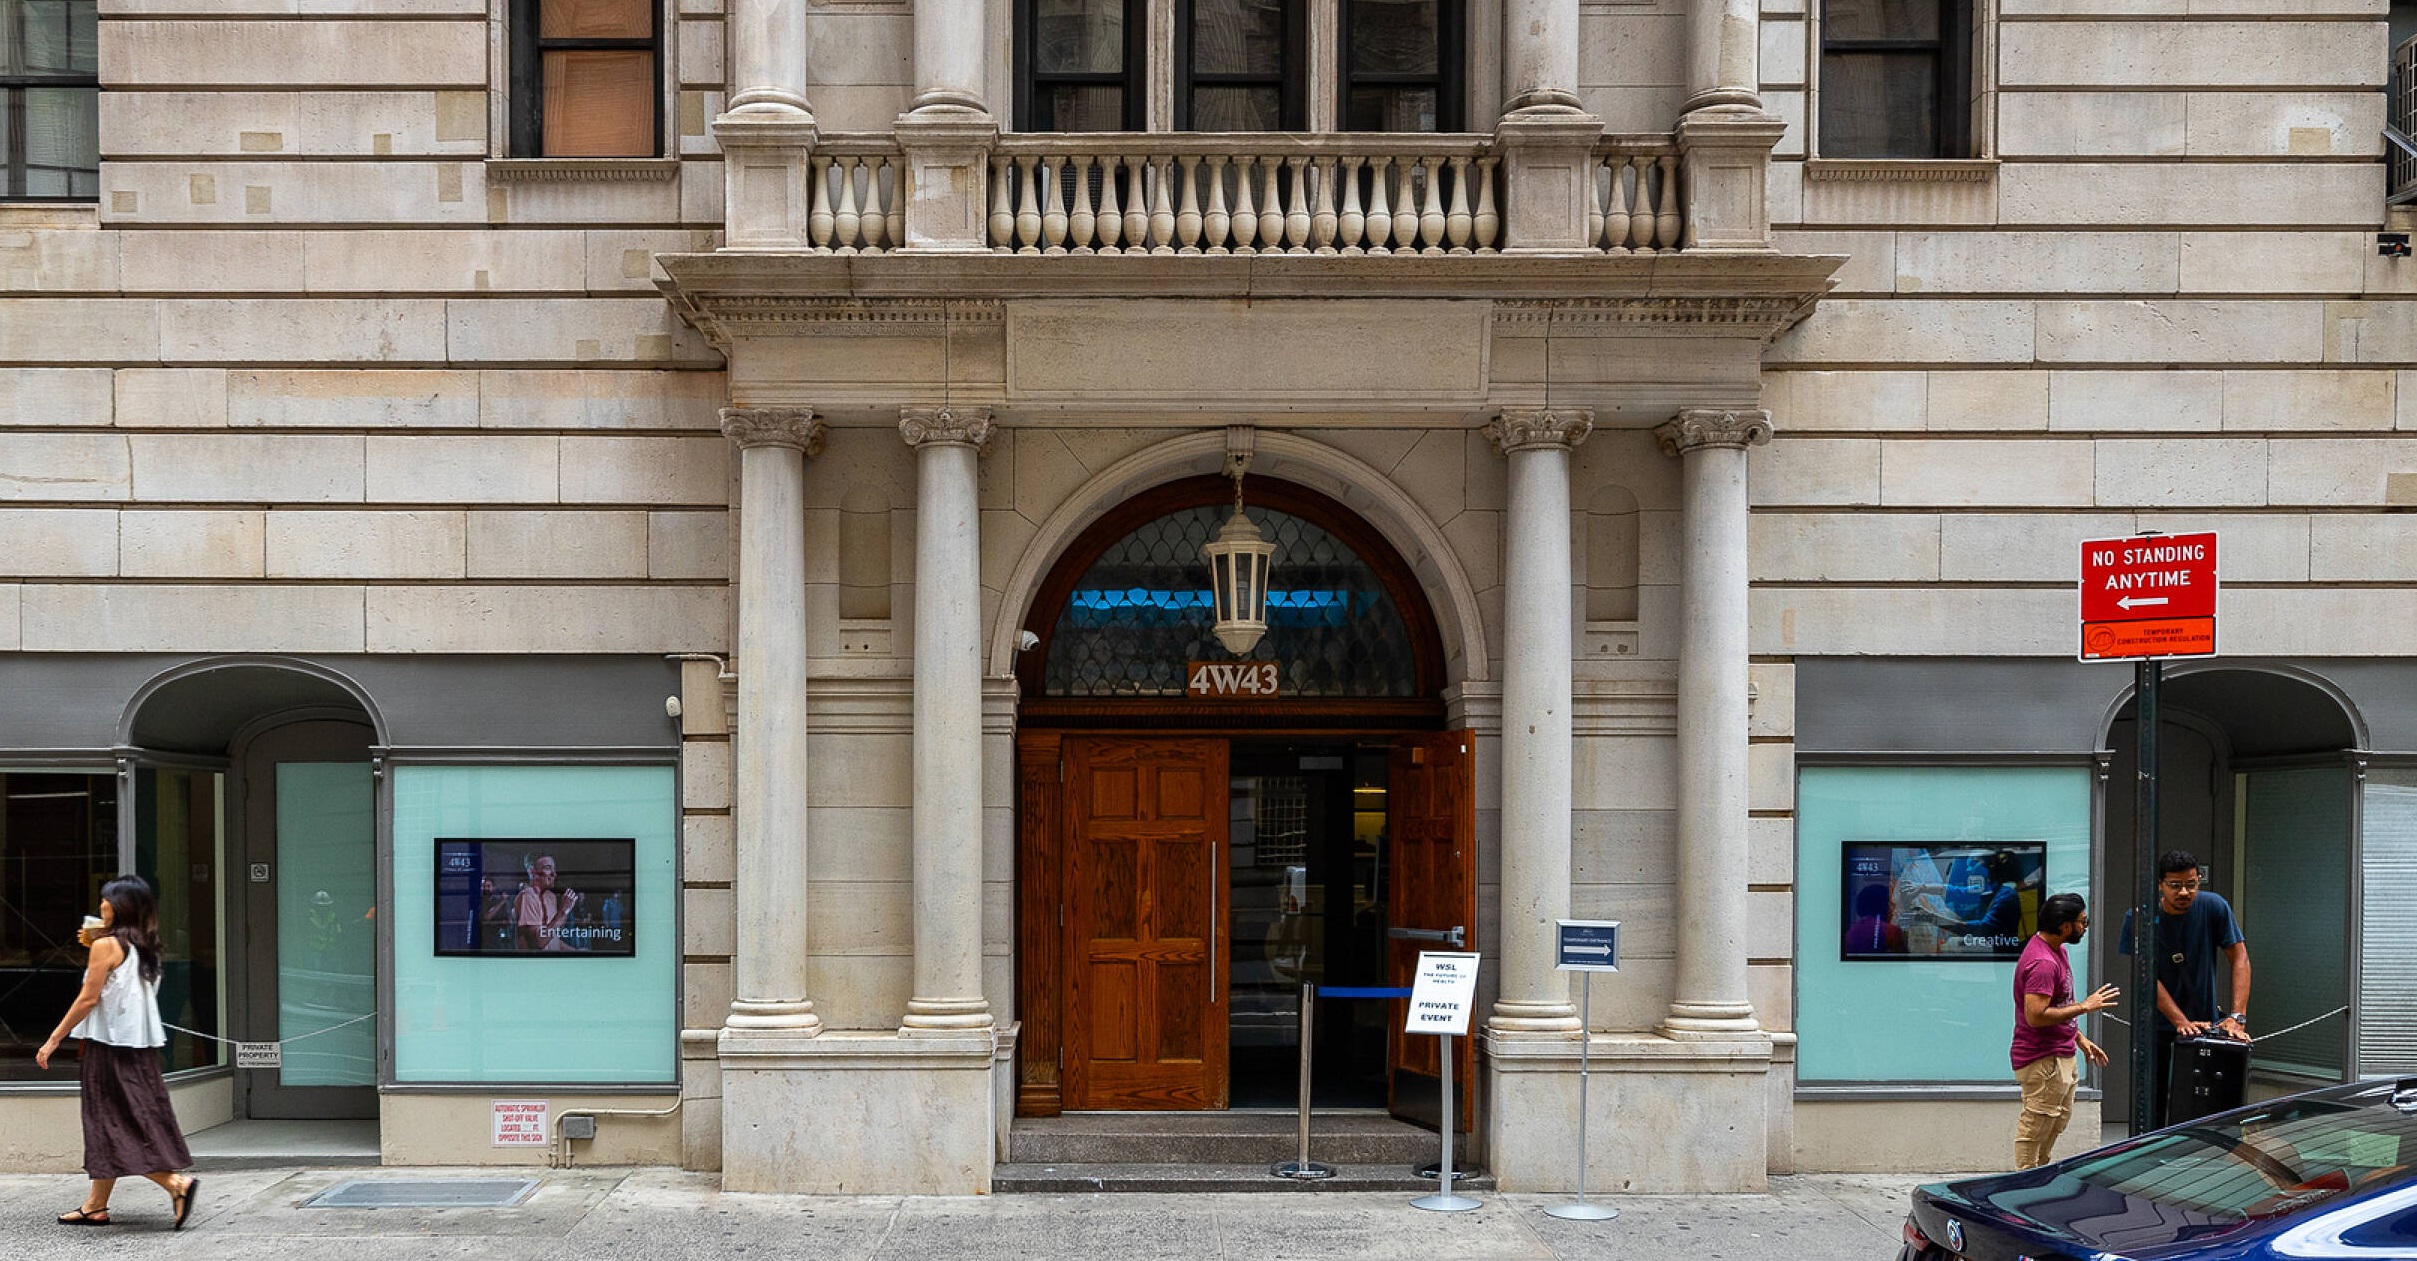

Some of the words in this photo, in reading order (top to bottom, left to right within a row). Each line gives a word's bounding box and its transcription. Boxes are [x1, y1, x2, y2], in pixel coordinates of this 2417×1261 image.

[2092, 550, 2115, 566] NO
[2123, 544, 2205, 565] STANDING
[2104, 569, 2192, 590] ANYTIME
[2116, 636, 2168, 645] CONSTRUCTION
[2169, 634, 2211, 642] REGULATION
[1190, 664, 1278, 695] 4W43
[540, 925, 622, 941] Entertaining
[1963, 933, 2019, 947] Creative
[1435, 963, 1457, 971] WSL
[1418, 1002, 1460, 1010] PRIVATE
[1420, 1014, 1453, 1022] EVENT
[238, 1052, 279, 1060] PROPERTY
[495, 1104, 520, 1112] AUTOMATIC
[521, 1104, 546, 1112] SPRINKLER
[525, 1114, 539, 1122] VALVE
